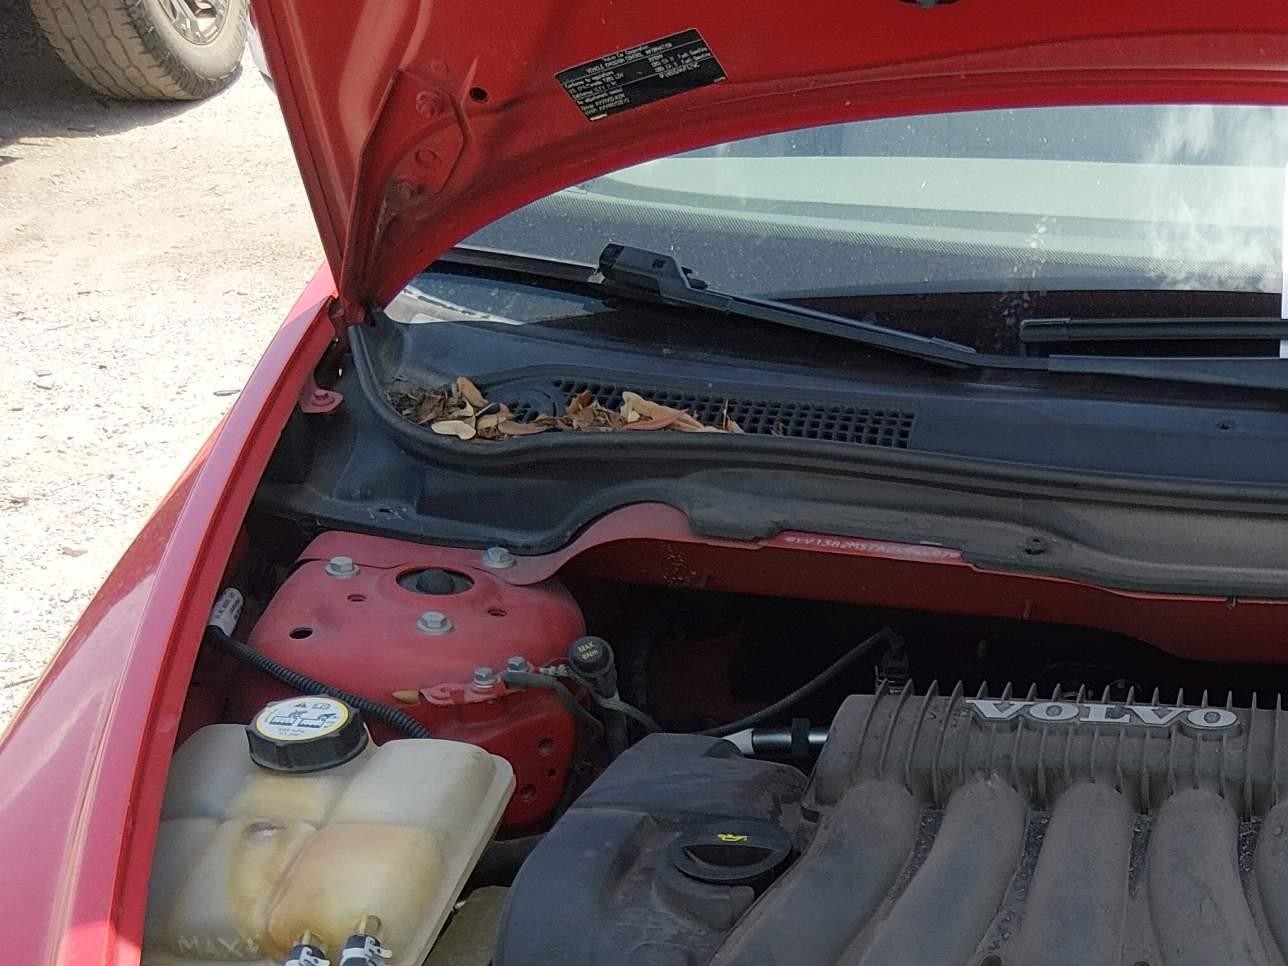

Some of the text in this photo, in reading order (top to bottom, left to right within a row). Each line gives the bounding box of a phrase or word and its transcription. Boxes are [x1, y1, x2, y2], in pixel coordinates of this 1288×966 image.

[577, 641, 595, 652] MAX
[965, 699, 1239, 728] VOLVO
[177, 935, 244, 958] MAX
